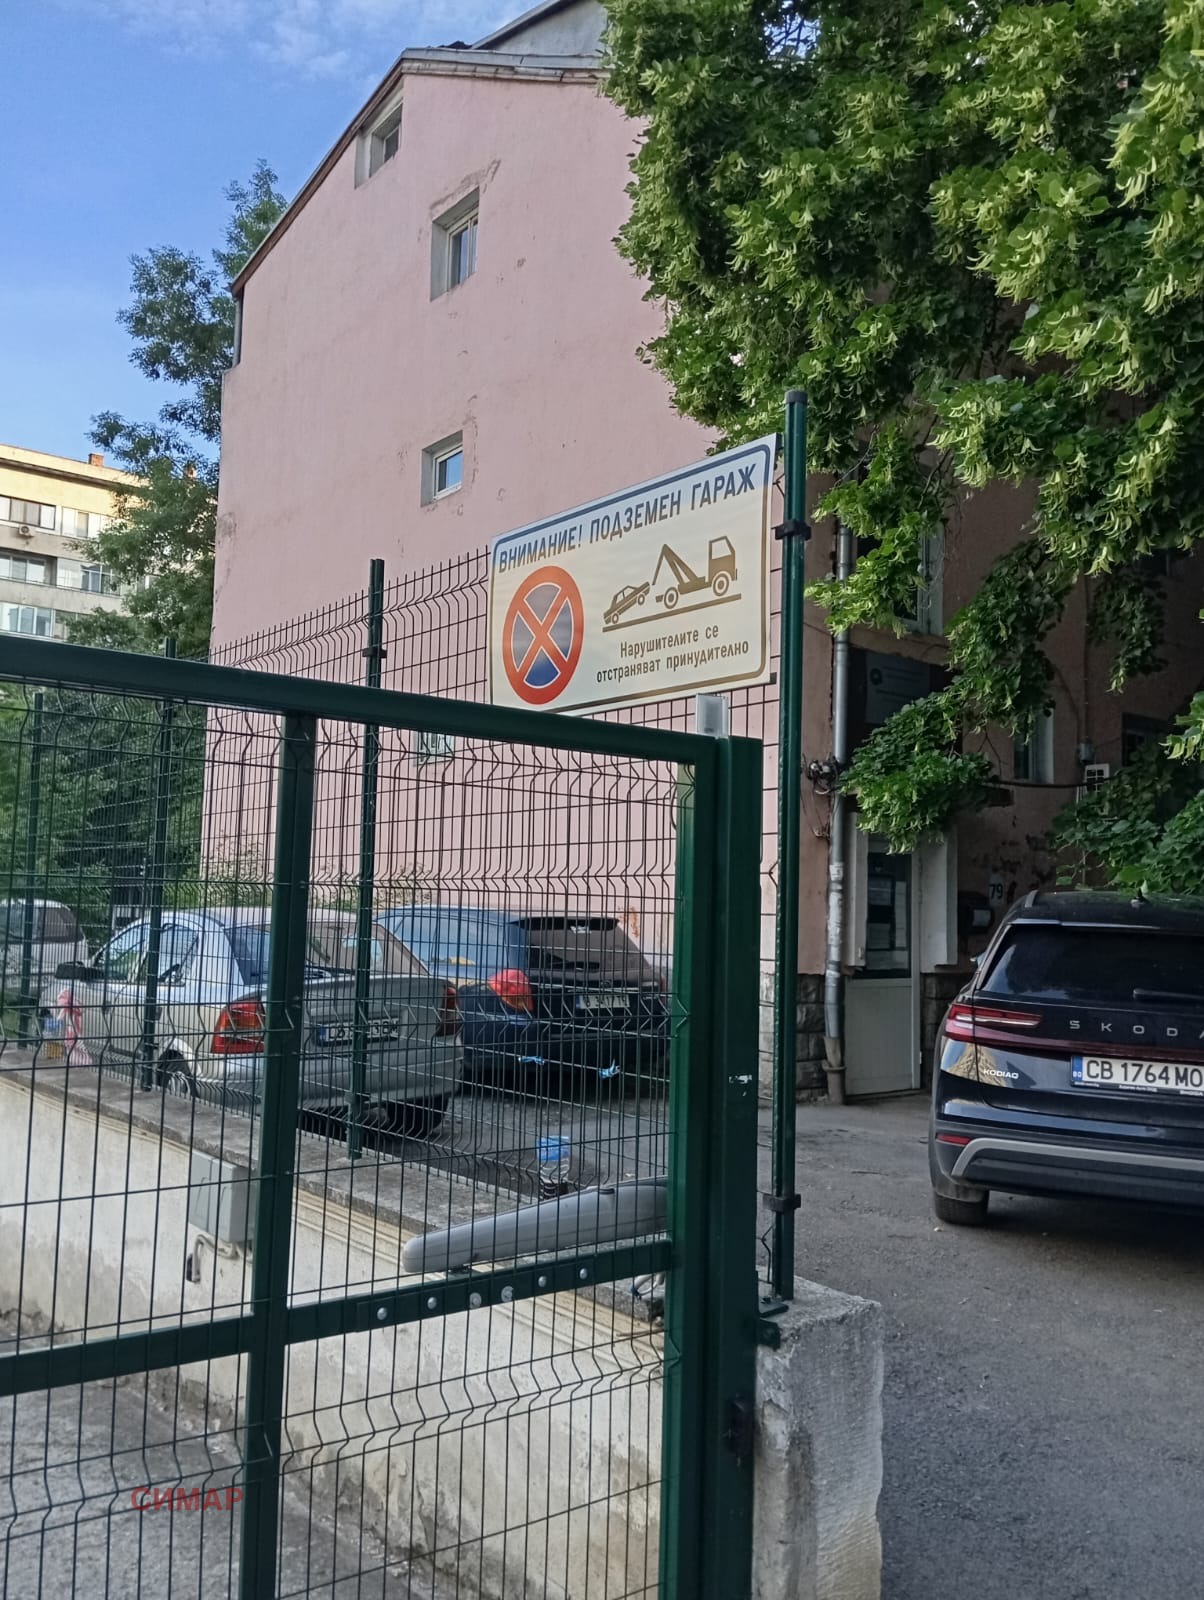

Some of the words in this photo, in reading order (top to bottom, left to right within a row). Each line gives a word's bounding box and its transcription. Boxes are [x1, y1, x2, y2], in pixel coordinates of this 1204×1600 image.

[498, 524, 583, 574] ВНИМАНИЕ!
[589, 489, 682, 542] ПОДЗЕМЕН
[690, 463, 757, 511] ГАРАЖ
[620, 628, 699, 660] Нарушителите
[705, 624, 719, 640] се
[596, 658, 661, 684] отстраняват
[666, 640, 749, 673] принудително
[989, 883, 1004, 900] 79
[983, 1068, 1019, 1080] KODIAQ
[1086, 1059, 1114, 1080] CB
[1120, 1062, 1170, 1085] 1764
